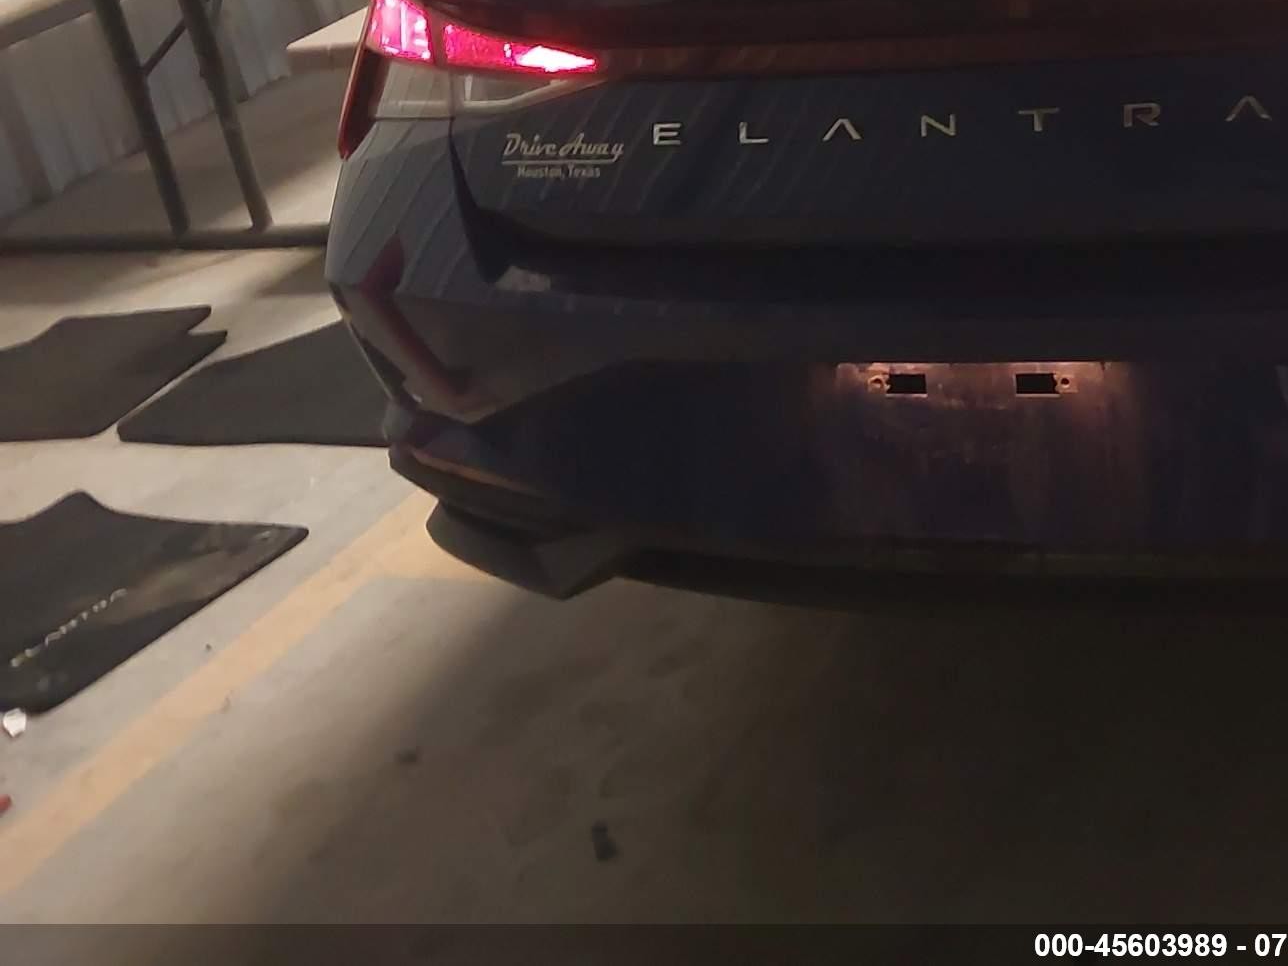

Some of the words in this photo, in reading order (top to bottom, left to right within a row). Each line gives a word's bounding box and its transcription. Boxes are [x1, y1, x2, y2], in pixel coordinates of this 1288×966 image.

[653, 95, 1272, 145] ELANTRA
[503, 132, 557, 156] Drive
[558, 132, 625, 163] Away
[567, 163, 601, 178] Texas
